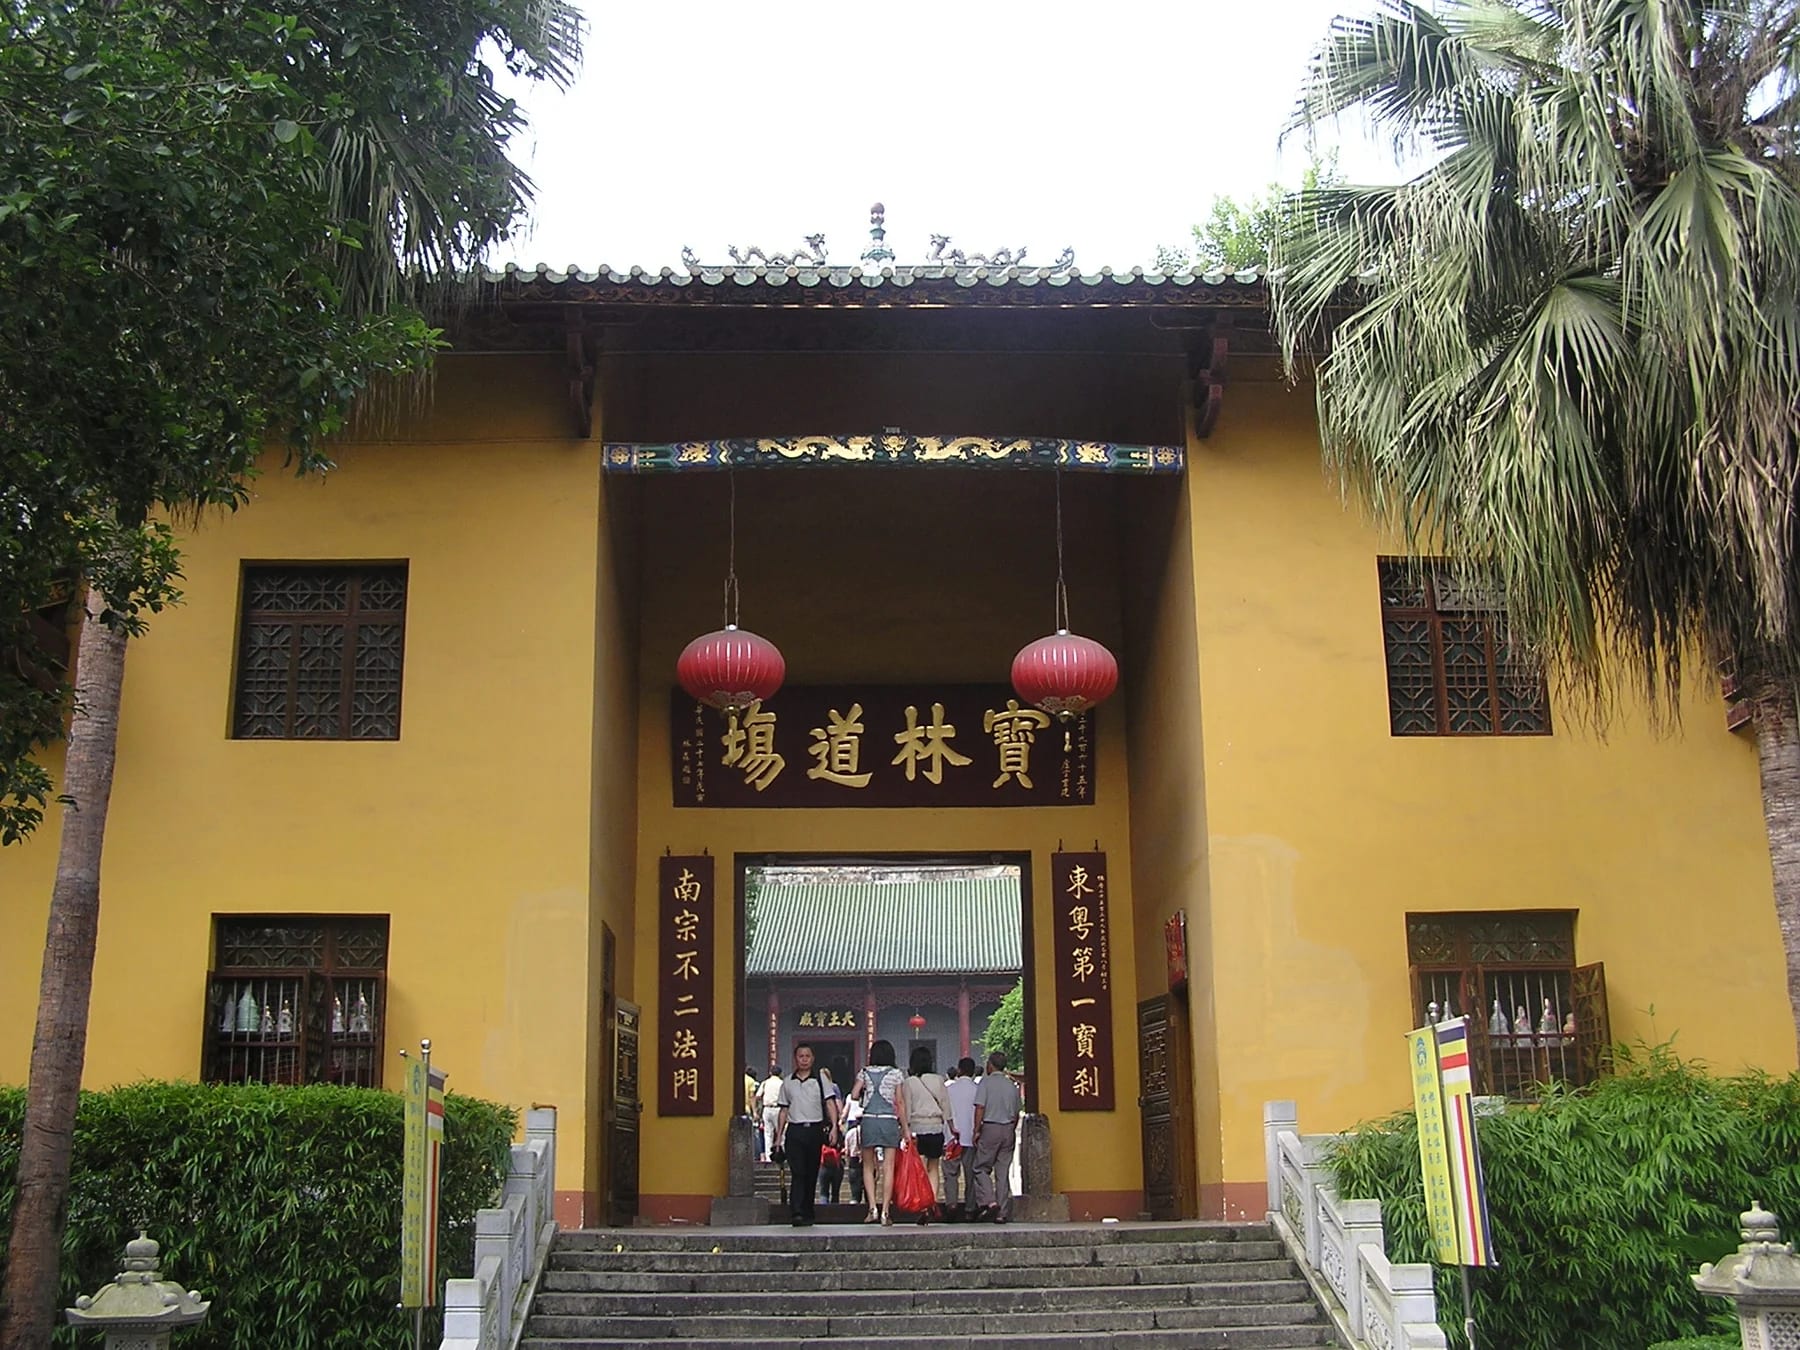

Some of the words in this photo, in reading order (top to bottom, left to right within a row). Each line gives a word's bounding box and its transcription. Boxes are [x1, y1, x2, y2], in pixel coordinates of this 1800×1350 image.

[671, 867, 702, 1102] 南宗不二法門
